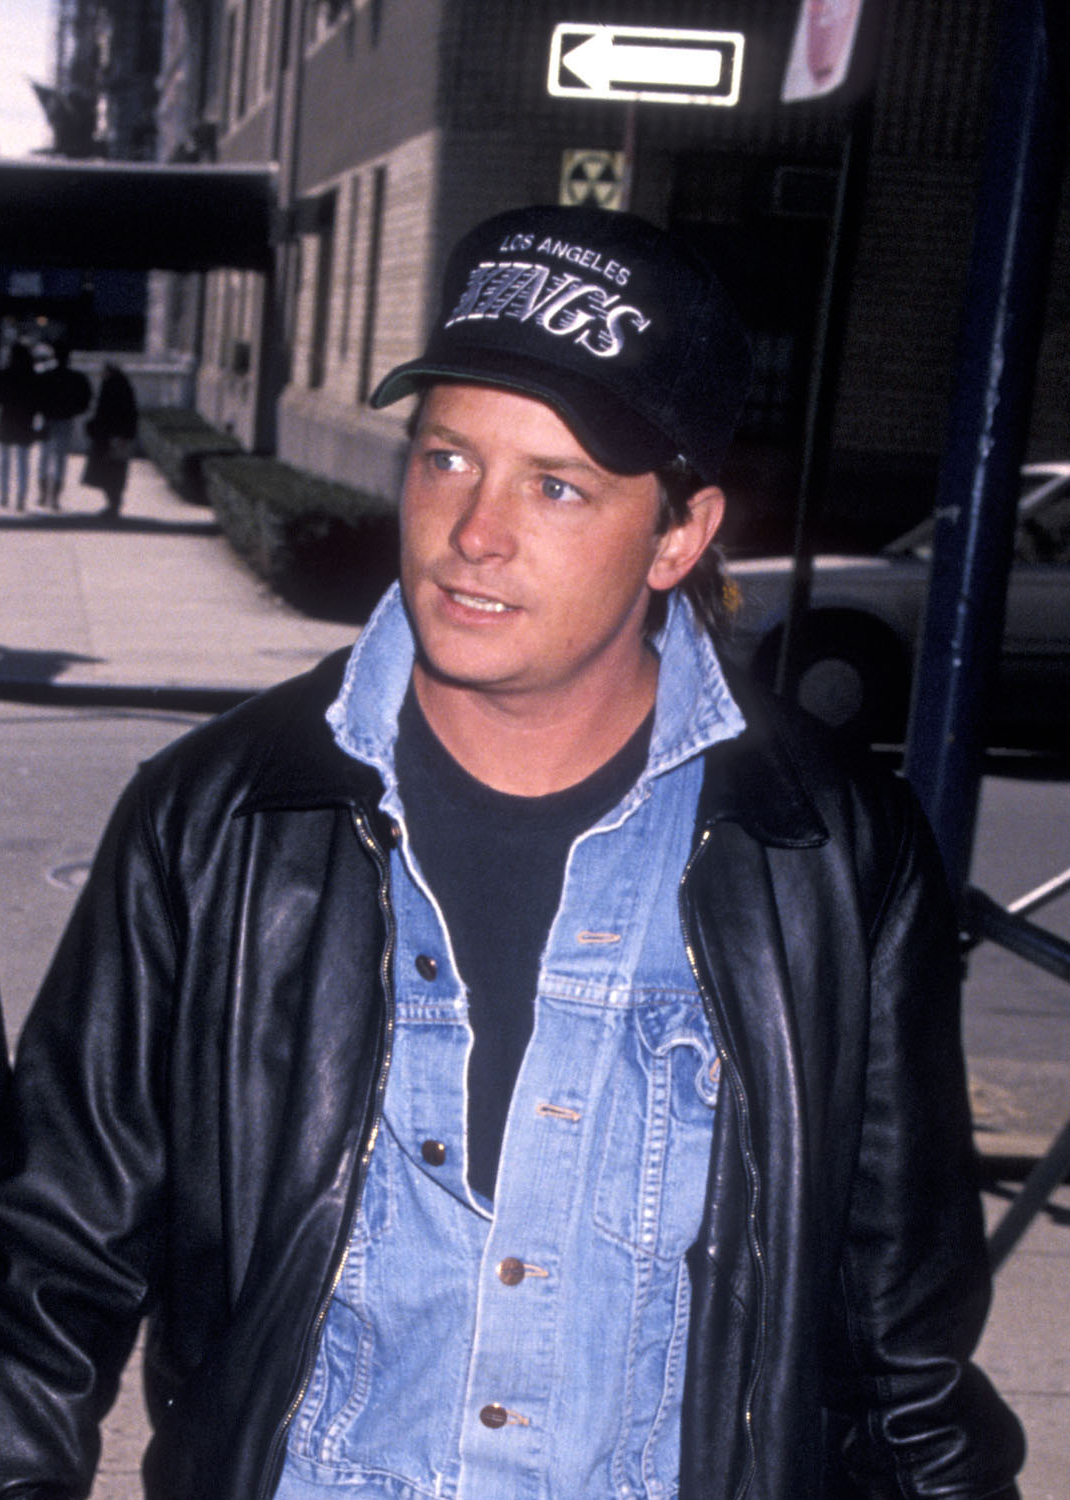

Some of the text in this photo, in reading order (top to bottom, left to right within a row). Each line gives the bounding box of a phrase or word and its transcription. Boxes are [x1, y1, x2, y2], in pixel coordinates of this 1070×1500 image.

[499, 234, 631, 286] LOS ANGELES
[444, 262, 651, 357] KINGS
